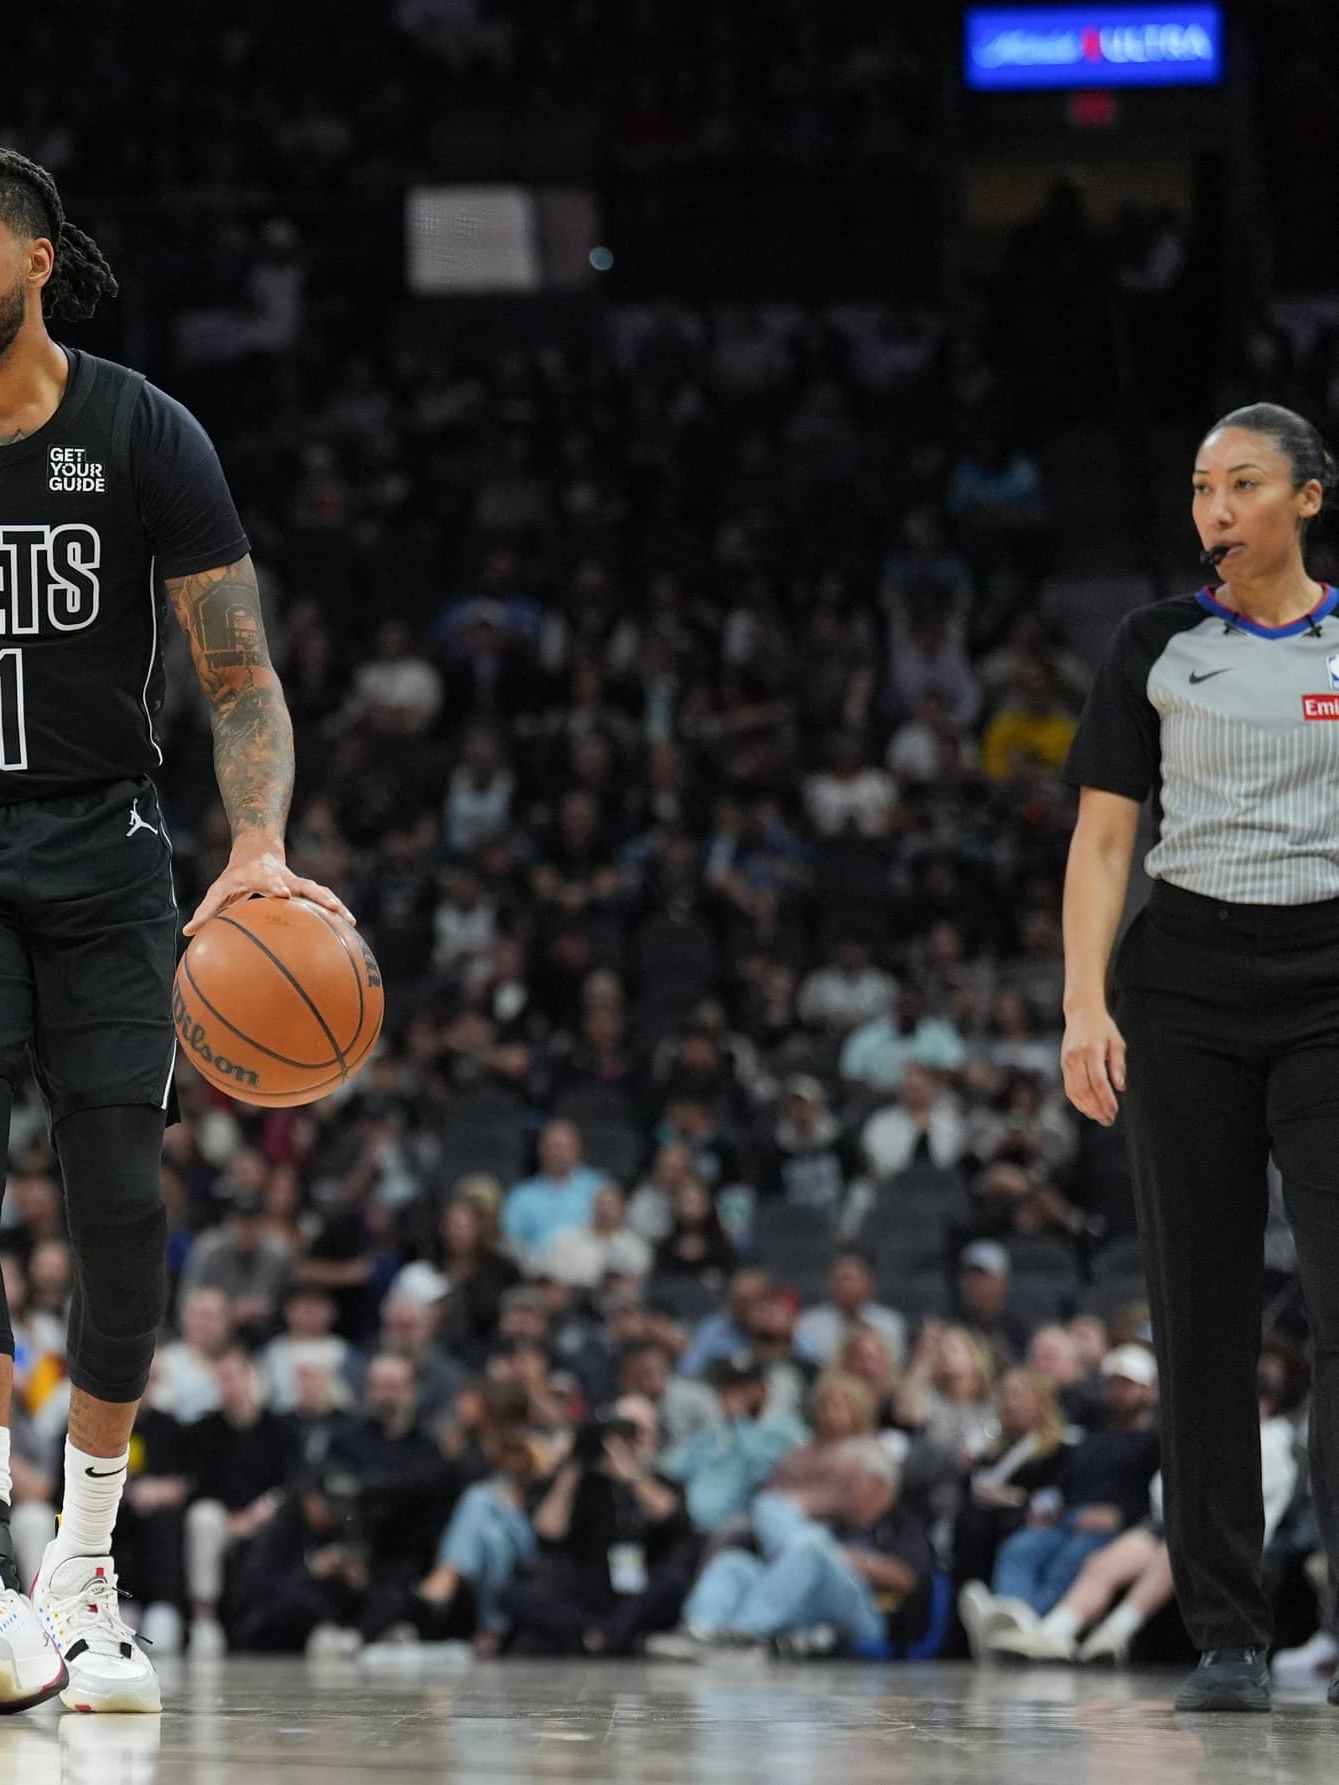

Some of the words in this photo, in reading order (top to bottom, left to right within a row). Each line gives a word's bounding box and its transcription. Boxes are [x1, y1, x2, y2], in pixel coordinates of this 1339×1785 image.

[50, 447, 85, 463] GET
[49, 462, 103, 478] YOUR
[48, 476, 105, 493] GUIDE
[172, 978, 259, 1088] Wilson
